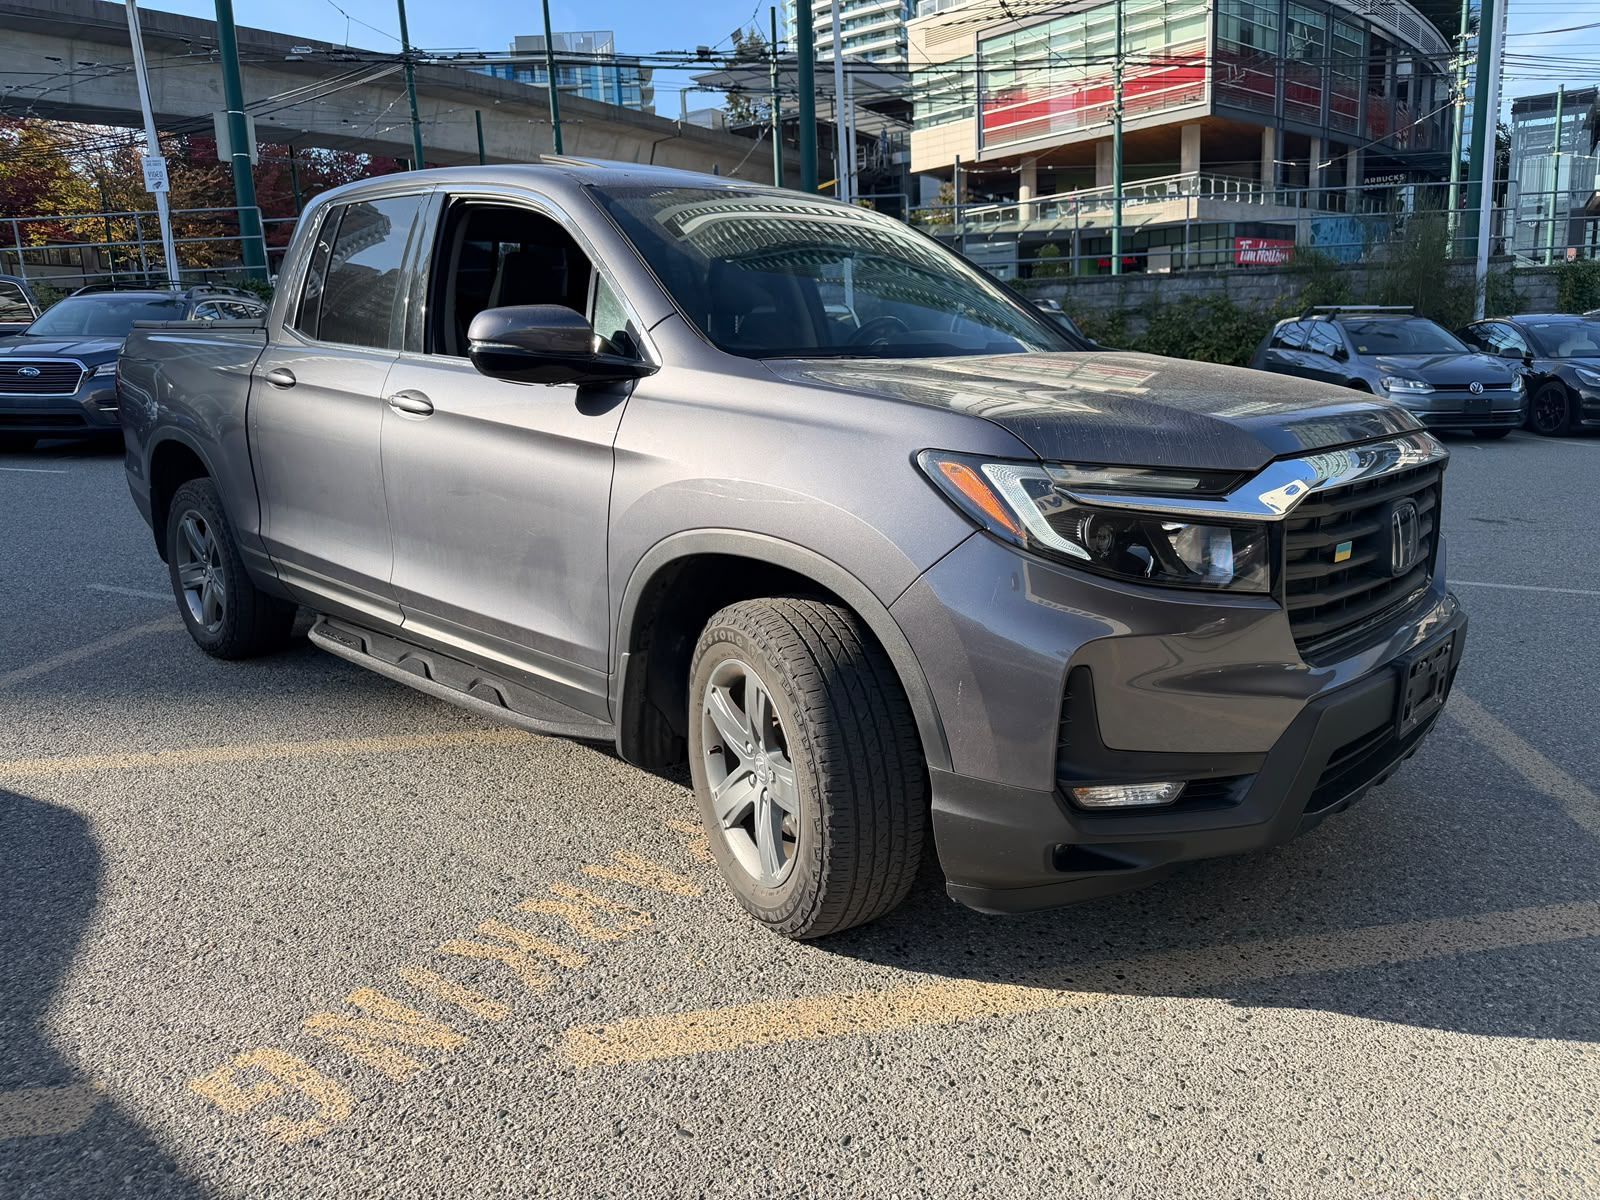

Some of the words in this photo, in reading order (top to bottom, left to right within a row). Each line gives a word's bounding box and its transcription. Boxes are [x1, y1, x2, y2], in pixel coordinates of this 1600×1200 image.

[147, 170, 163, 178] VIDEO
[1363, 173, 1405, 185] ARBUCKS
[1239, 239, 1257, 262] Tim
